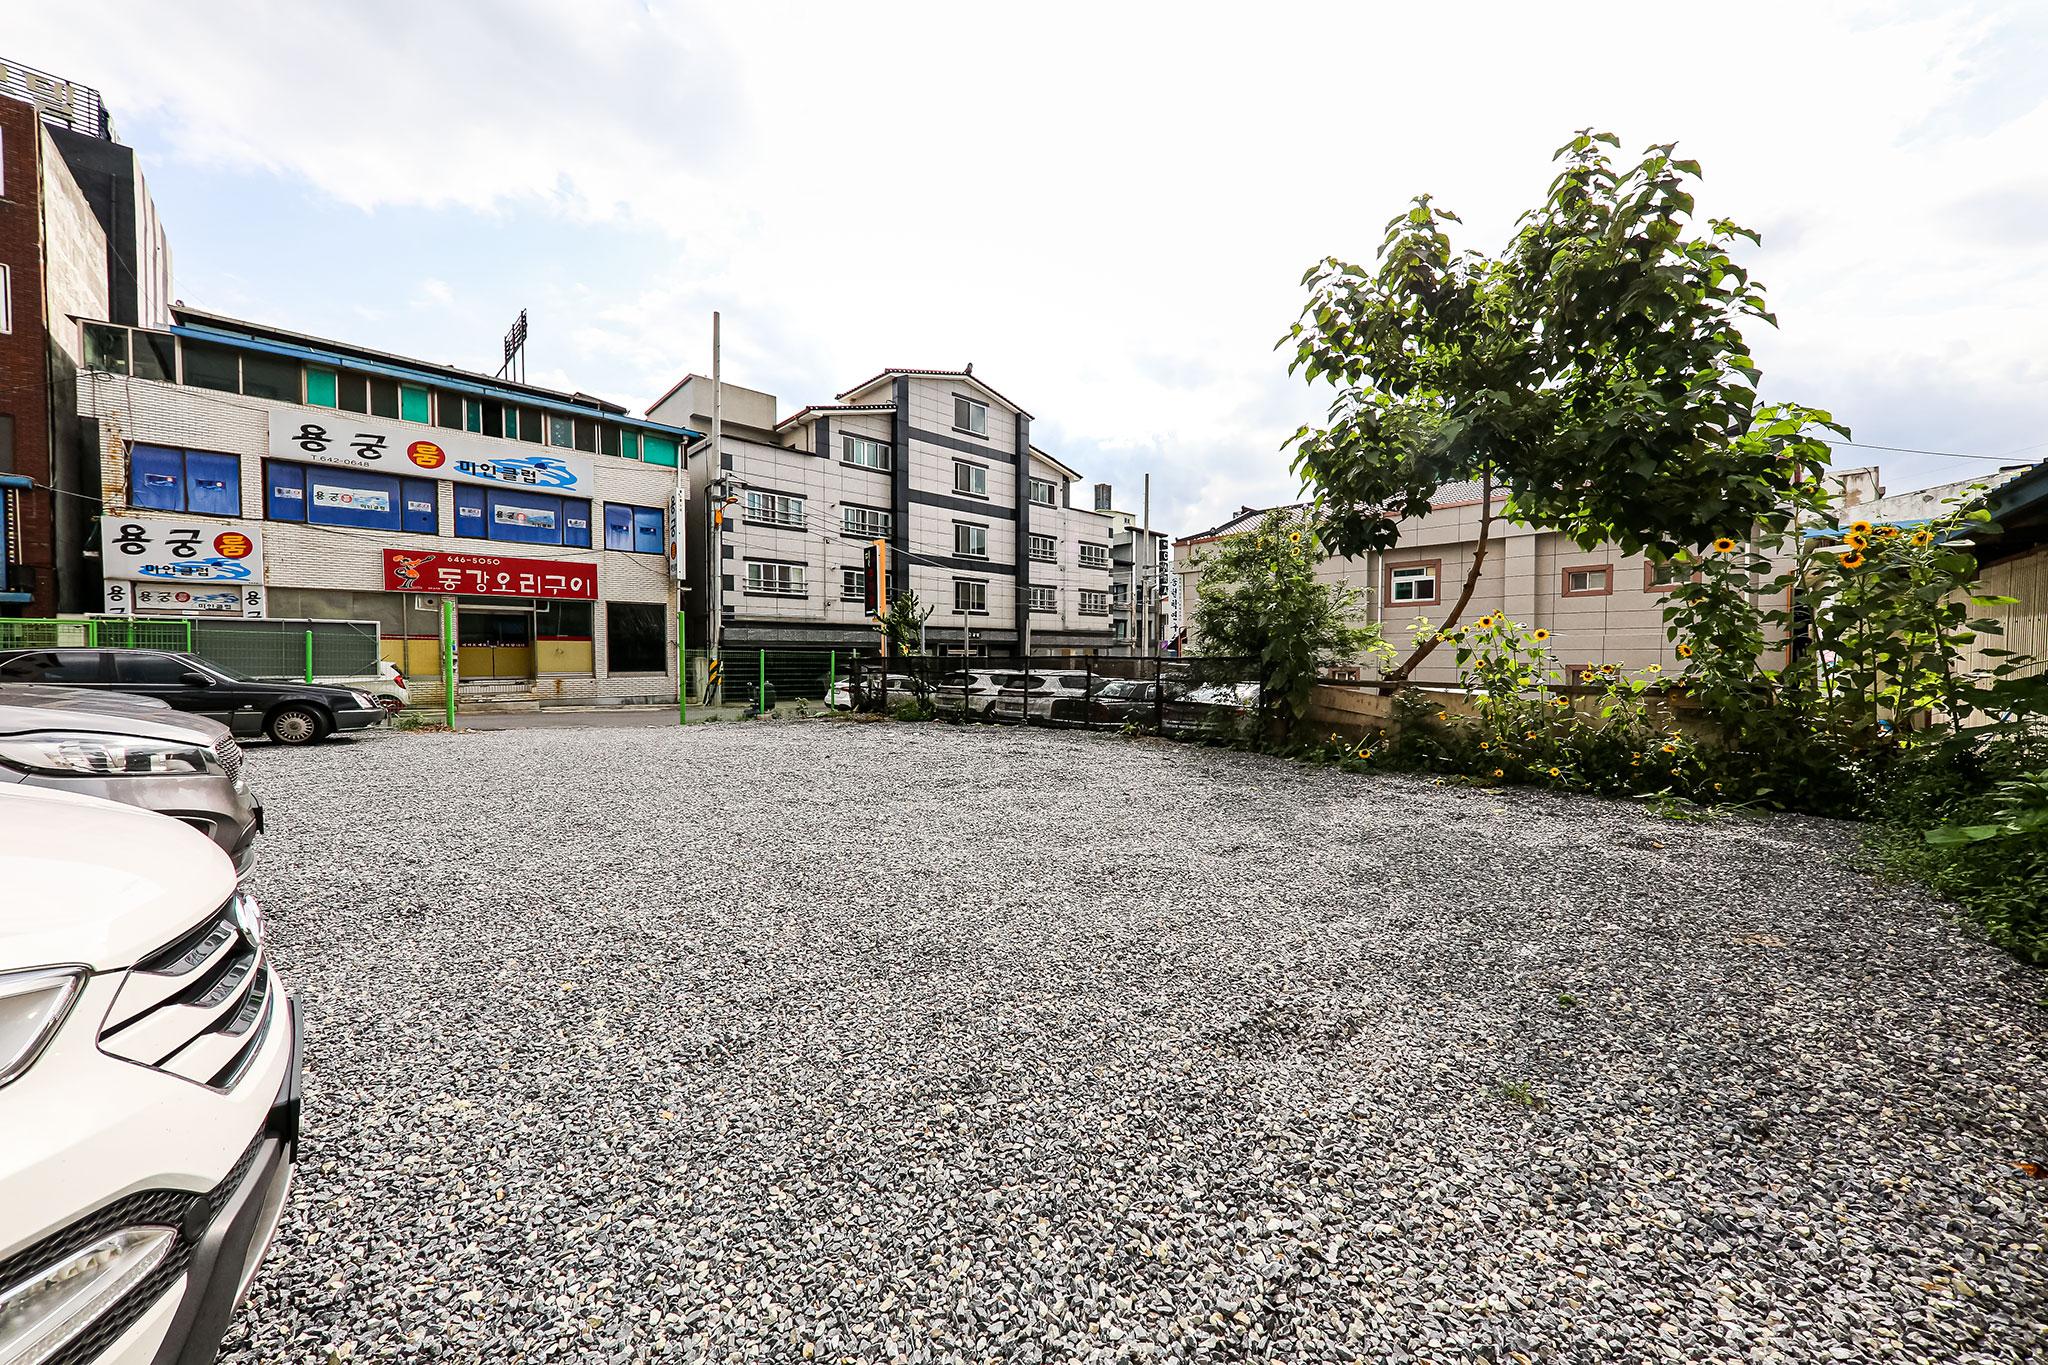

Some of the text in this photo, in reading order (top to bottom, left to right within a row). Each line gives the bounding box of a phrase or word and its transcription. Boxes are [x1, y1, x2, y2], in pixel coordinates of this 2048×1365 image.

[0, 64, 78, 123] 텔
[291, 424, 537, 484] 용궁 룸 미인클럽
[111, 524, 246, 558] 용궁 룸
[145, 564, 209, 577] 미인클럽
[447, 556, 500, 566] 646-5050
[437, 567, 590, 597] 동강오리구이
